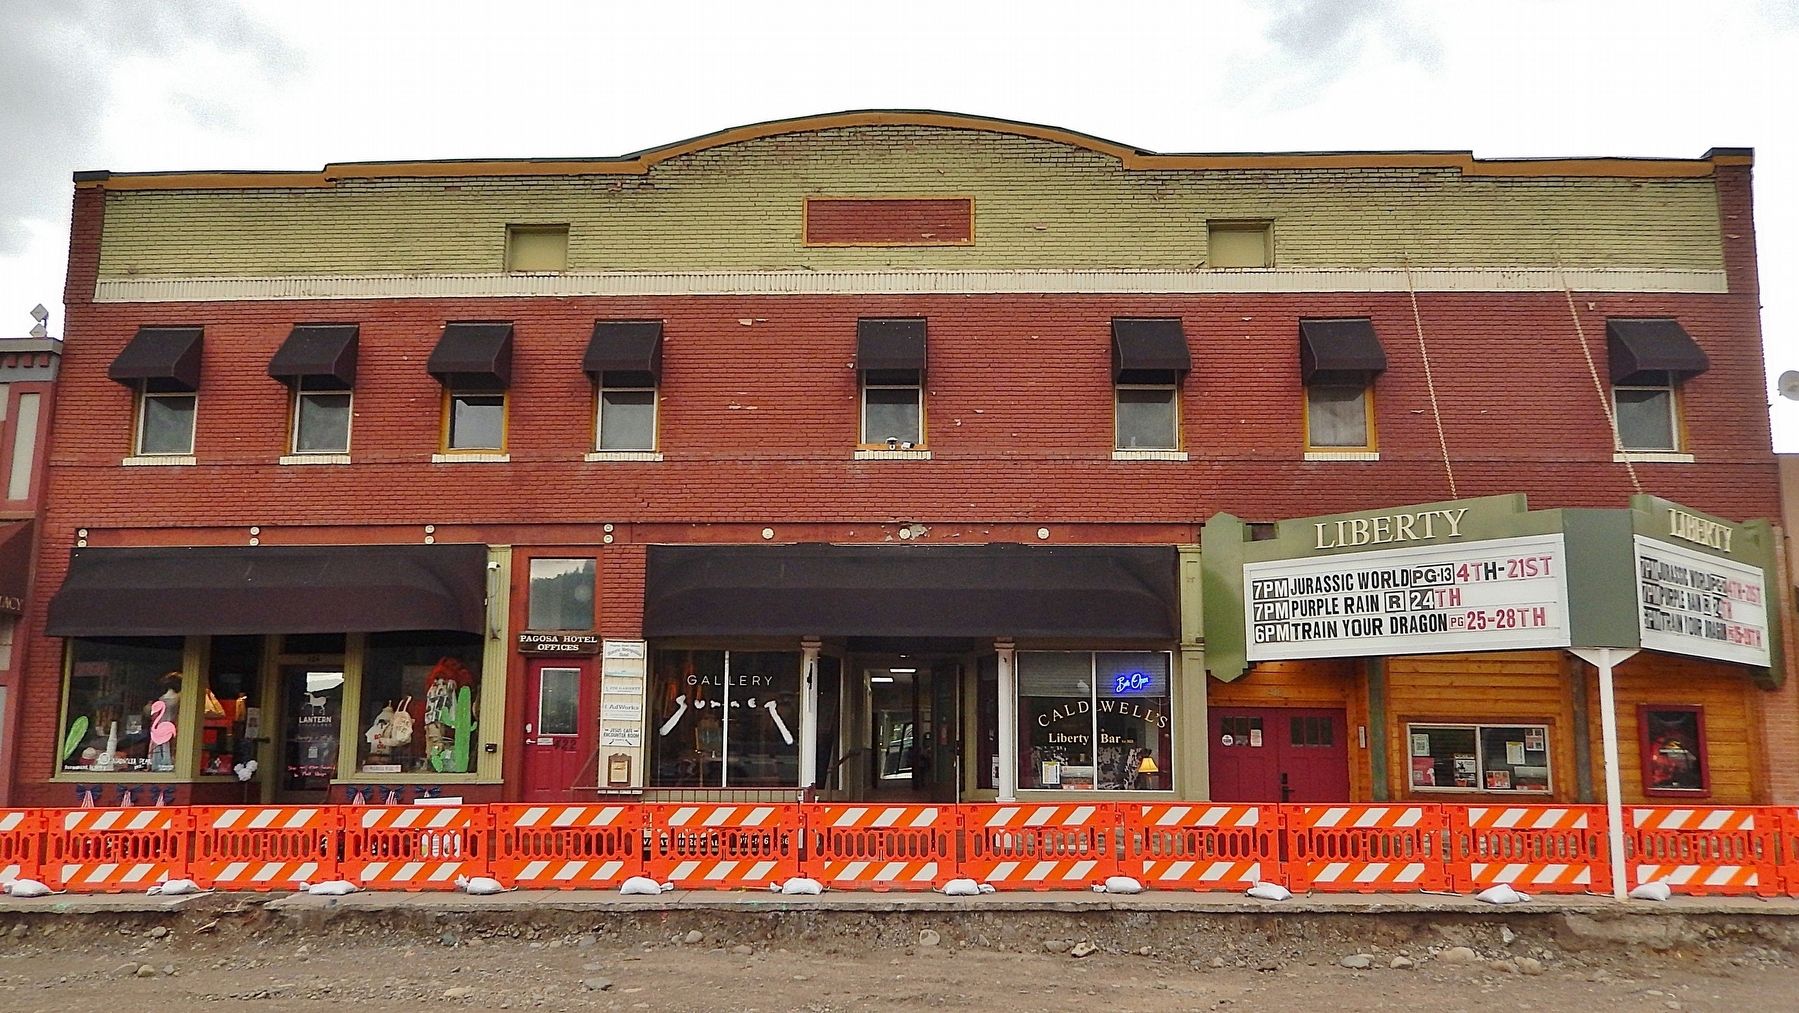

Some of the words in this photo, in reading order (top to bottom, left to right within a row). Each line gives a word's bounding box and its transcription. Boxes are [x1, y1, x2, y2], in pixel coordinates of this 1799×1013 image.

[1314, 508, 1469, 549] LIBERTY
[1668, 509, 1734, 552] LIBERTY
[1252, 580, 1288, 599] 7PM
[1291, 573, 1354, 595] JURASSIC
[1357, 569, 1409, 589] WORLD
[1253, 601, 1289, 621] 7PM
[1292, 597, 1339, 617] PURPLE
[1344, 594, 1379, 614] RAIN
[1388, 594, 1401, 609] R
[1410, 588, 1461, 610] 24TH
[520, 635, 558, 643] PAGOSA
[1254, 623, 1290, 643] 6PM
[1292, 620, 1338, 640] TRAIN
[1342, 618, 1383, 637] YOUR
[1390, 613, 1447, 635] DRAGON
[1450, 616, 1464, 628] PG
[1467, 607, 1545, 630] 25-28TH
[687, 675, 773, 686] GALLERY
[1038, 701, 1168, 728] CALDWELL'S
[1048, 733, 1090, 745] Liberty
[1101, 733, 1121, 744] Bar
